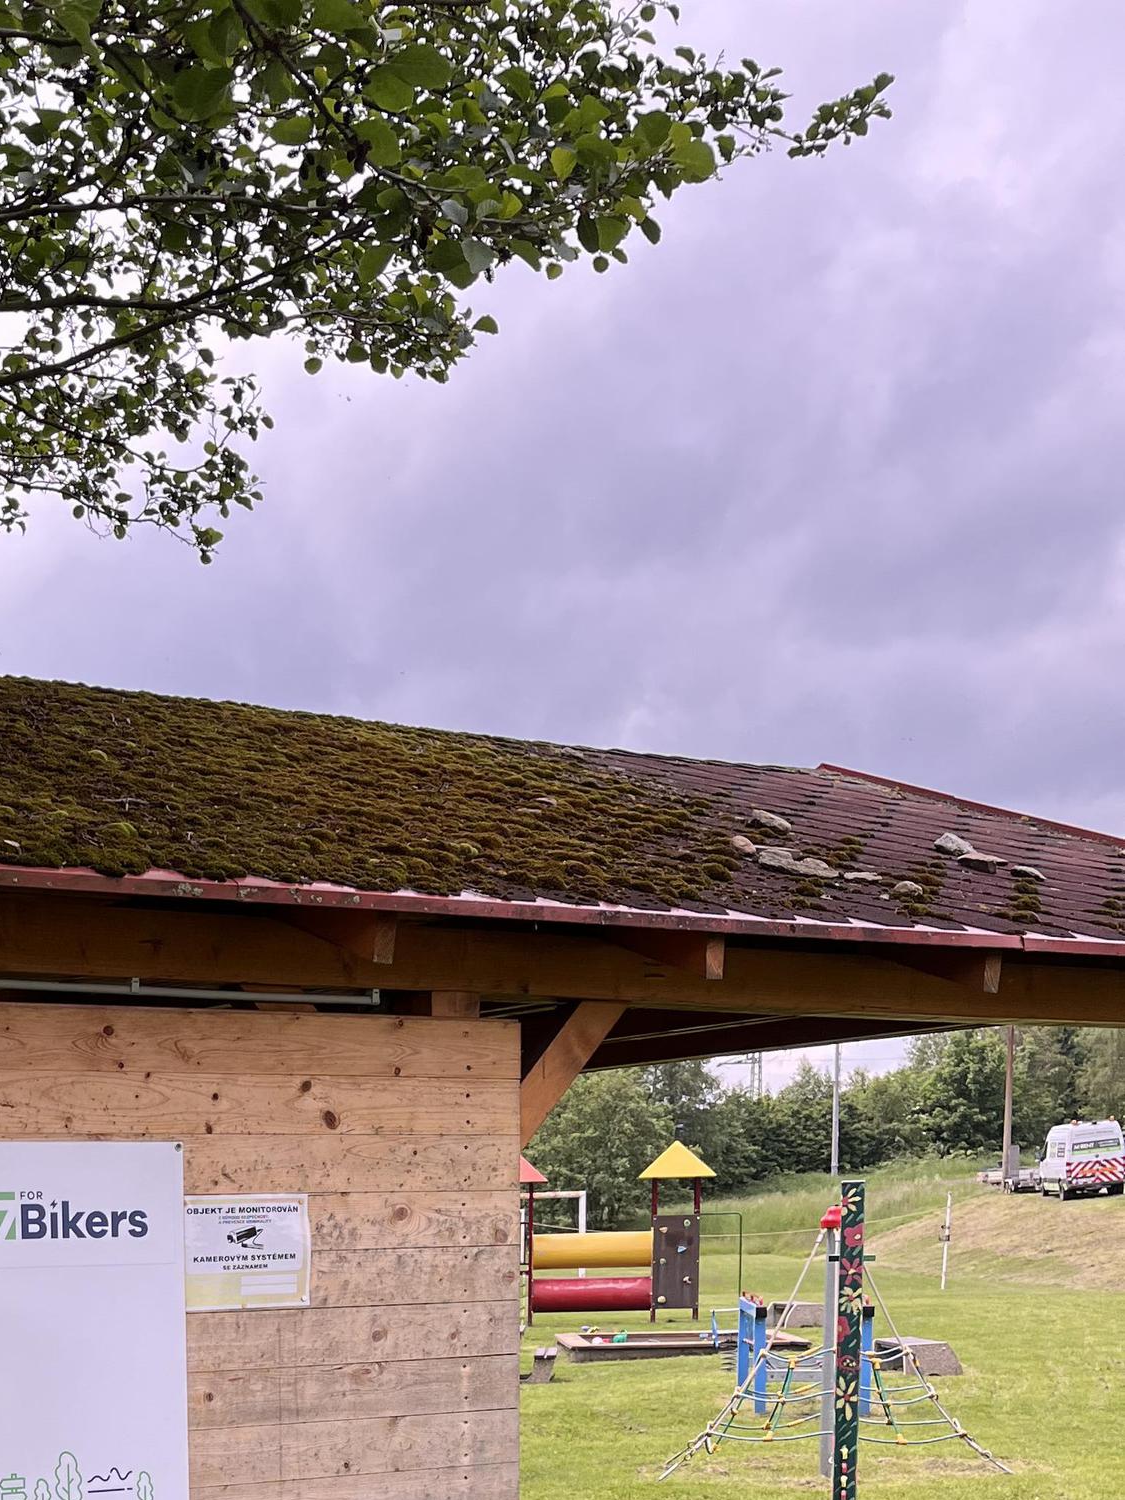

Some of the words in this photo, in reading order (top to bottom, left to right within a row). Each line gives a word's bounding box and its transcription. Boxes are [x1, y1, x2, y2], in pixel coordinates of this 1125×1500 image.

[20, 1191, 43, 1200] FOR
[186, 1207, 223, 1215] OBJEKT
[238, 1205, 299, 1214] MONITOROVÁN
[20, 1200, 149, 1240] Bikers
[193, 1254, 249, 1263] KAMEROVÝM
[251, 1253, 296, 1261] SYSTÉMEM
